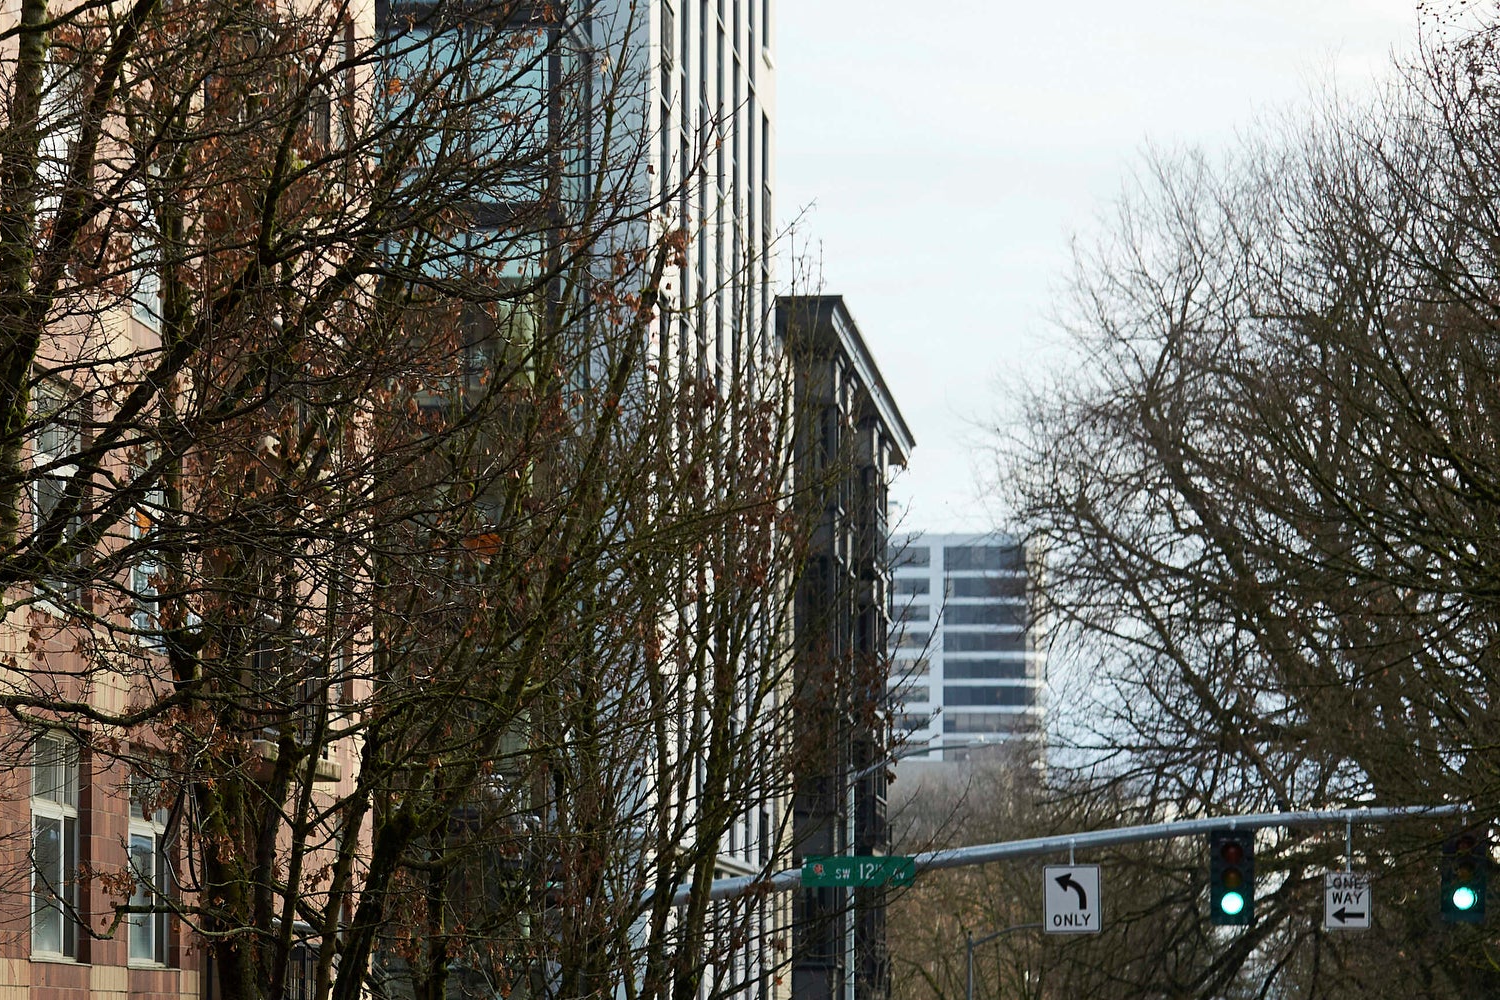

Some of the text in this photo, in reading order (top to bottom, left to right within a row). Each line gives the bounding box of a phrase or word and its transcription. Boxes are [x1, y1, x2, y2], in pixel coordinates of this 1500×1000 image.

[835, 868, 851, 880] SW
[1332, 877, 1363, 890] ONE
[1332, 891, 1363, 905] WAY
[1053, 913, 1091, 926] ONLY
